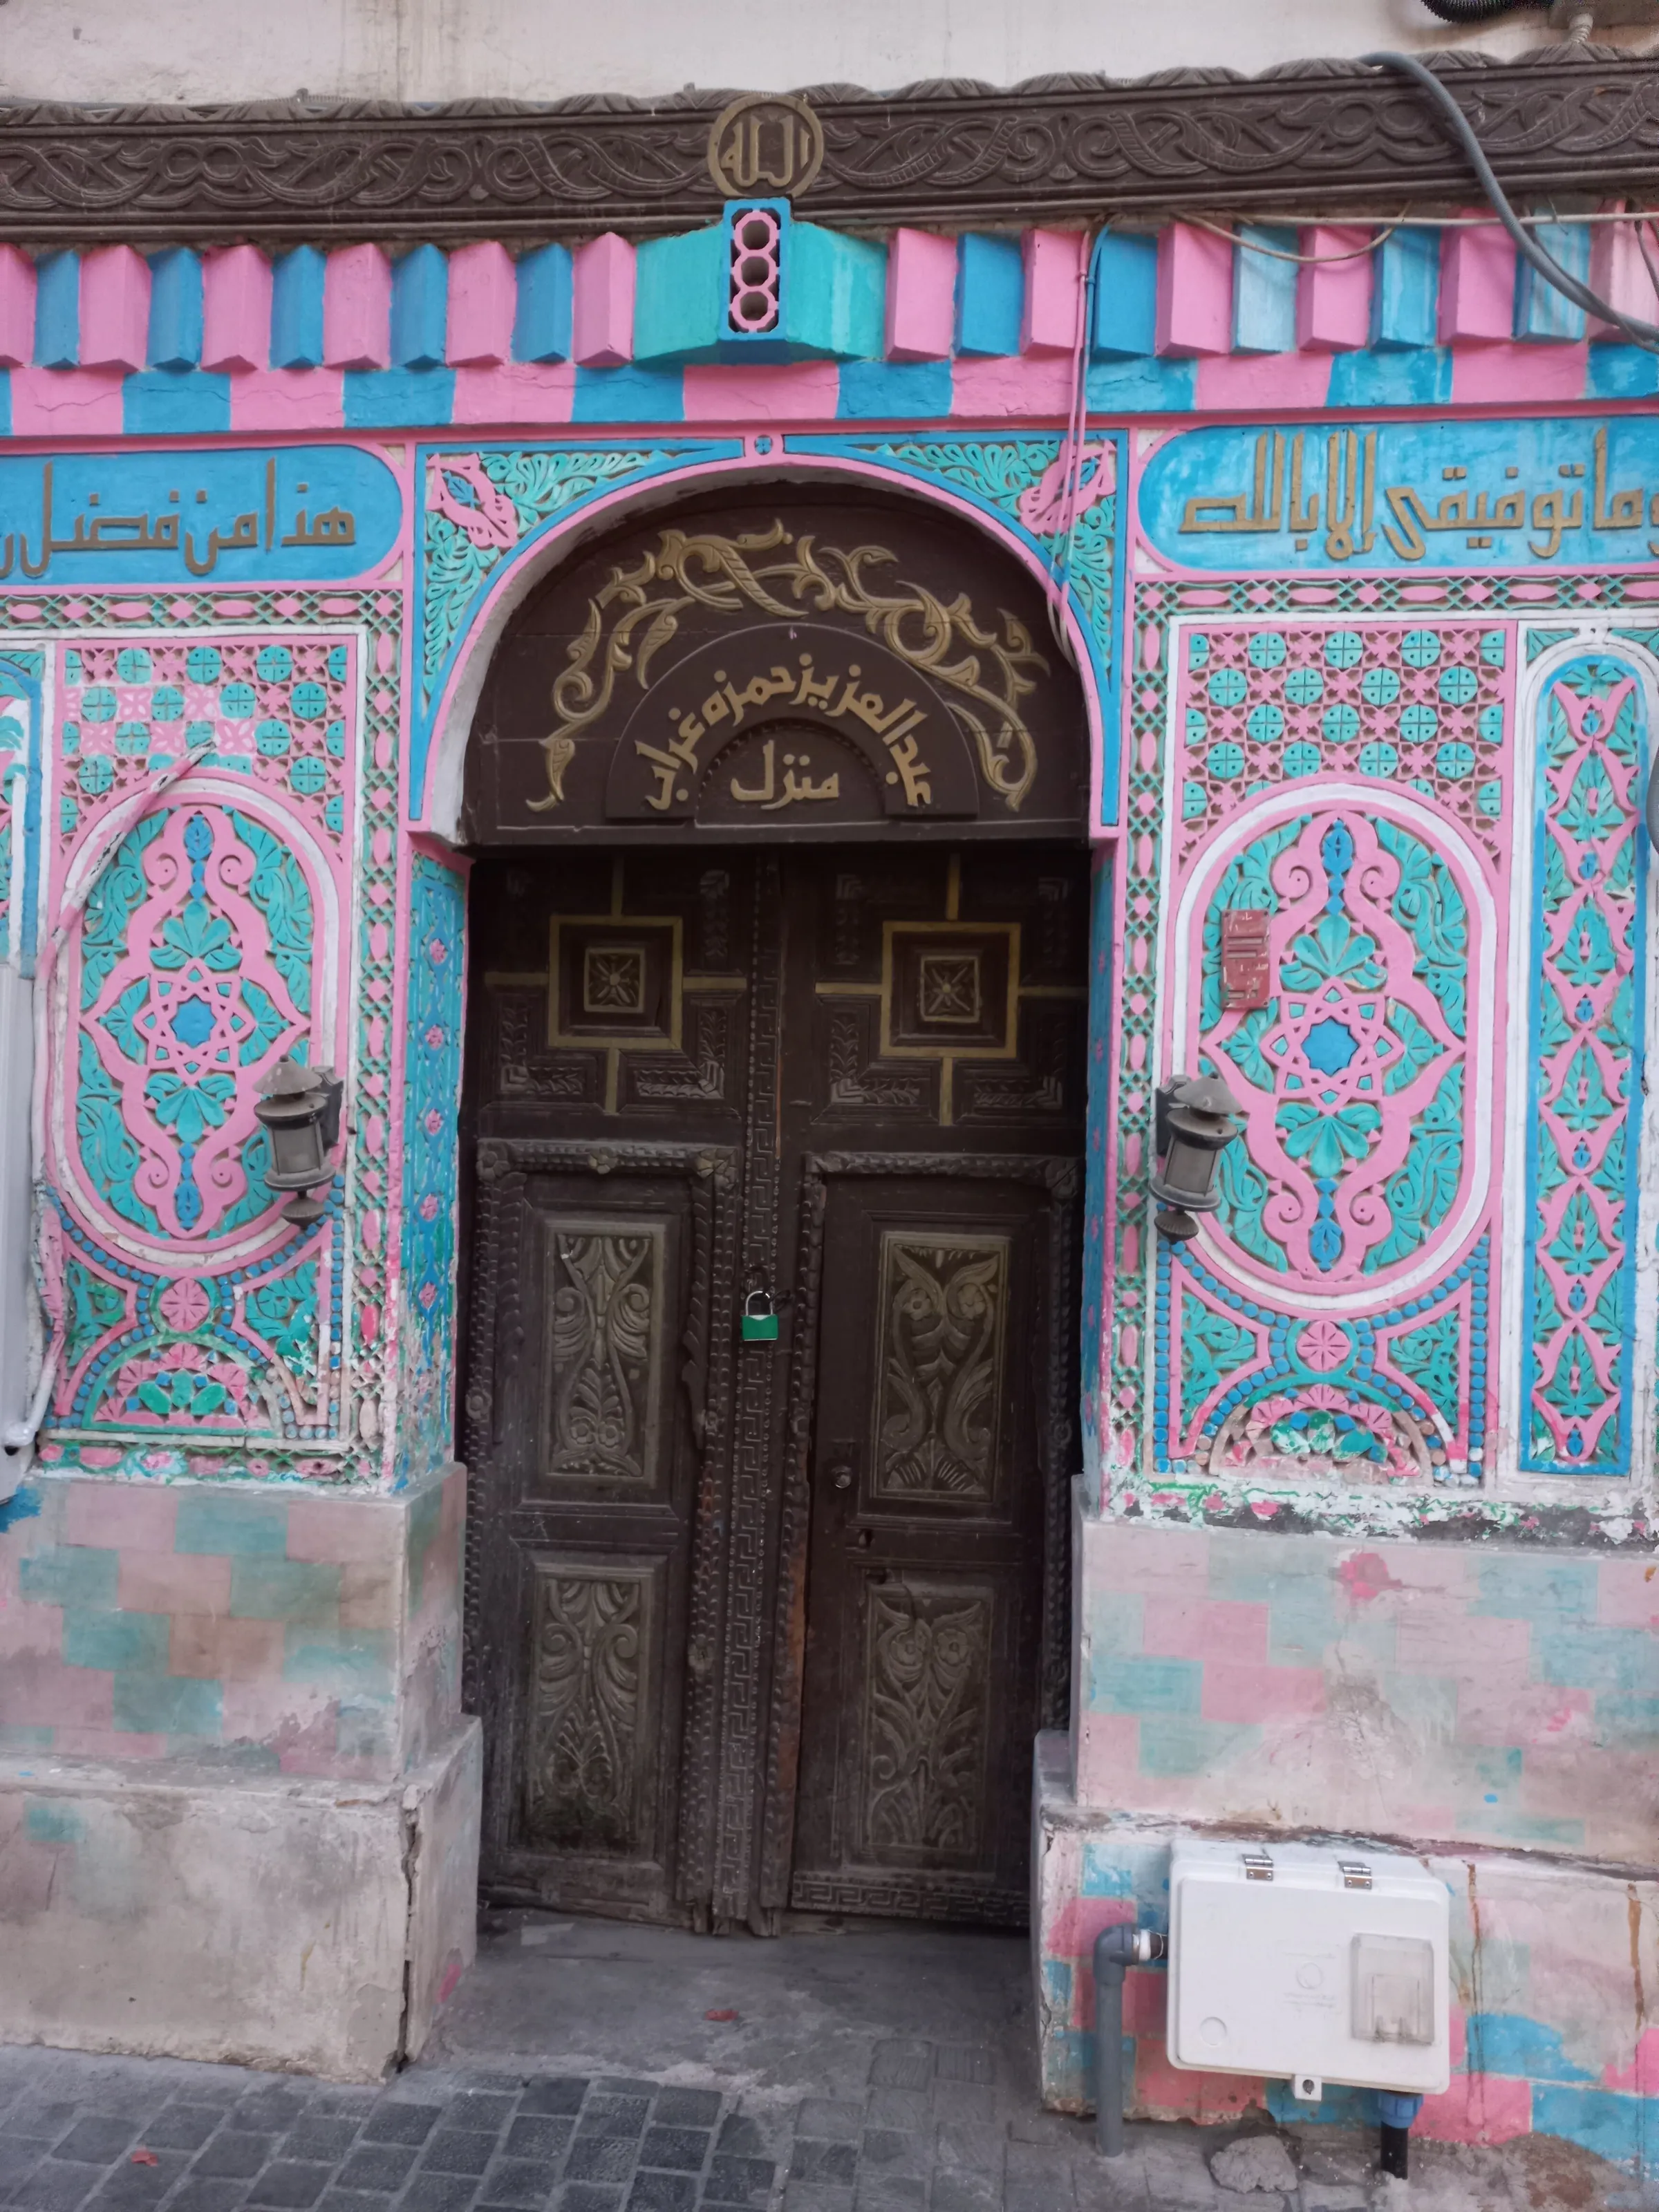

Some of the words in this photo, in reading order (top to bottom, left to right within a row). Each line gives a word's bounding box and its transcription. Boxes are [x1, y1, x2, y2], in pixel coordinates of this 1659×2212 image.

[720, 113, 809, 187] الله
[19, 459, 180, 579] فضل
[184, 489, 259, 576] من
[265, 455, 355, 554] هذا
[1179, 429, 1320, 552] بالله
[789, 653, 928, 746] العزيز
[635, 706, 706, 810] غراب
[730, 739, 839, 810] منزل
[885, 734, 931, 807] عبد
